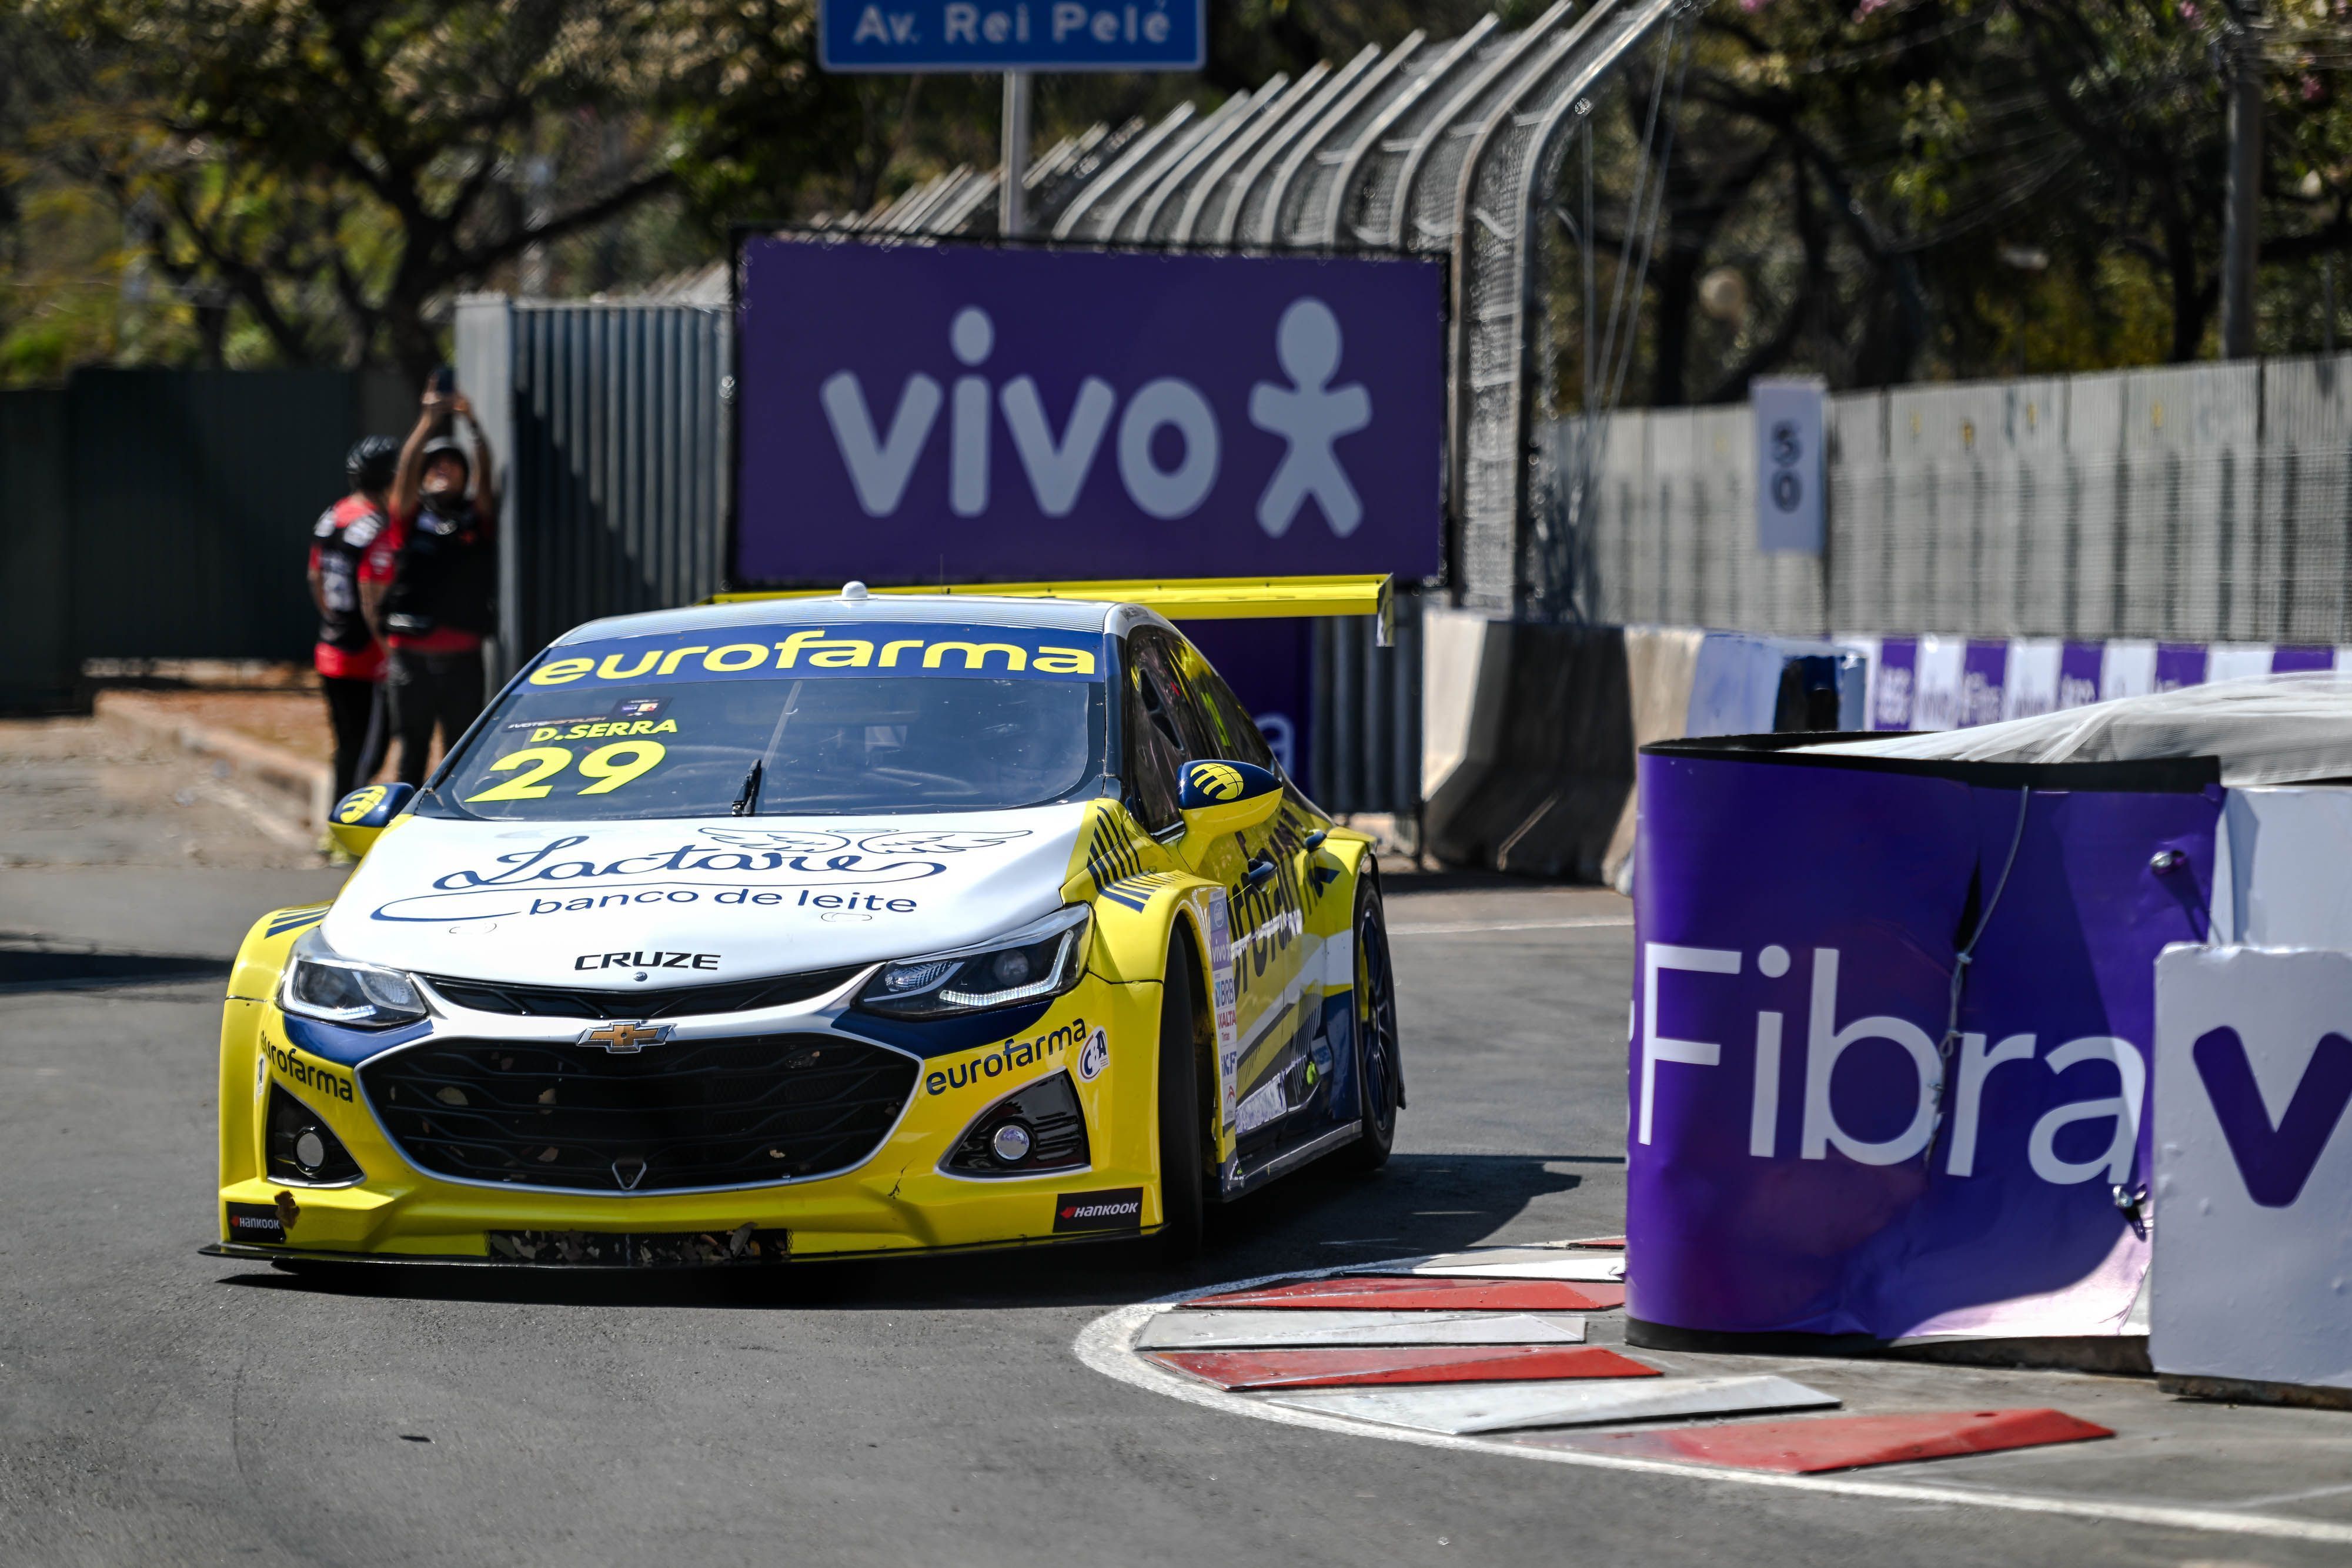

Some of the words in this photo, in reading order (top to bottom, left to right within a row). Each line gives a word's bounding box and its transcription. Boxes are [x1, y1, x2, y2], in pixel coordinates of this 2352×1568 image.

[853, 3, 921, 45] Av.
[944, 2, 1030, 45] Rei
[1053, 0, 1170, 44] Pelé
[820, 305, 1221, 520] vivo
[529, 630, 1095, 687] eurofarma
[529, 719, 678, 743] D.SERRA
[463, 740, 666, 803] 29
[529, 890, 700, 915] banco
[713, 888, 781, 905] de
[797, 889, 917, 913] leite
[573, 951, 721, 971] CRUZE
[1221, 977, 1235, 1007] BRB
[260, 1029, 353, 1103] eurofarma
[926, 1018, 1087, 1096] eurofarma
[1638, 941, 2147, 1186] Fibra
